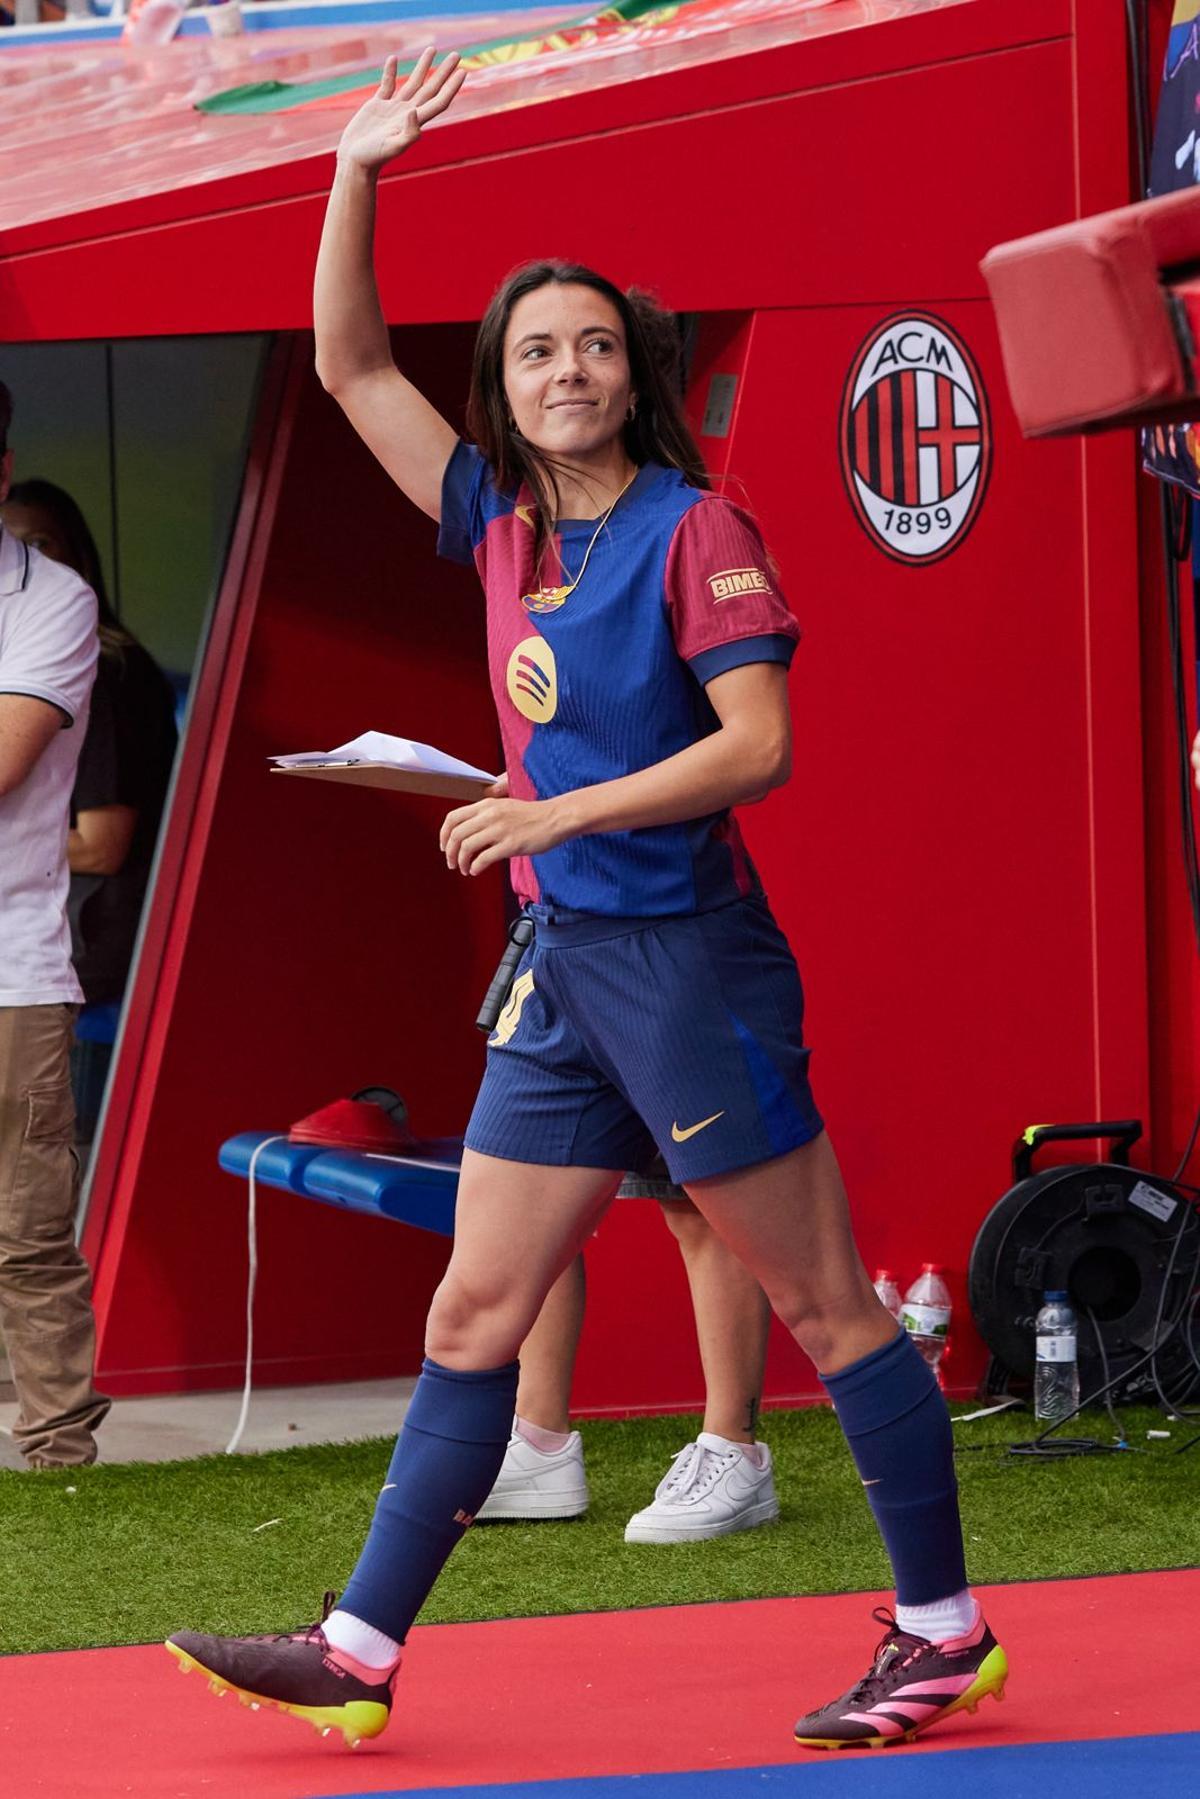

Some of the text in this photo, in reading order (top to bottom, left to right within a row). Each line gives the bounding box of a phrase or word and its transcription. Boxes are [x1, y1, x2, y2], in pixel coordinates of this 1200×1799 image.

[871, 331, 953, 378] ACM
[883, 507, 952, 535] 1899
[711, 571, 769, 598] BIMB
